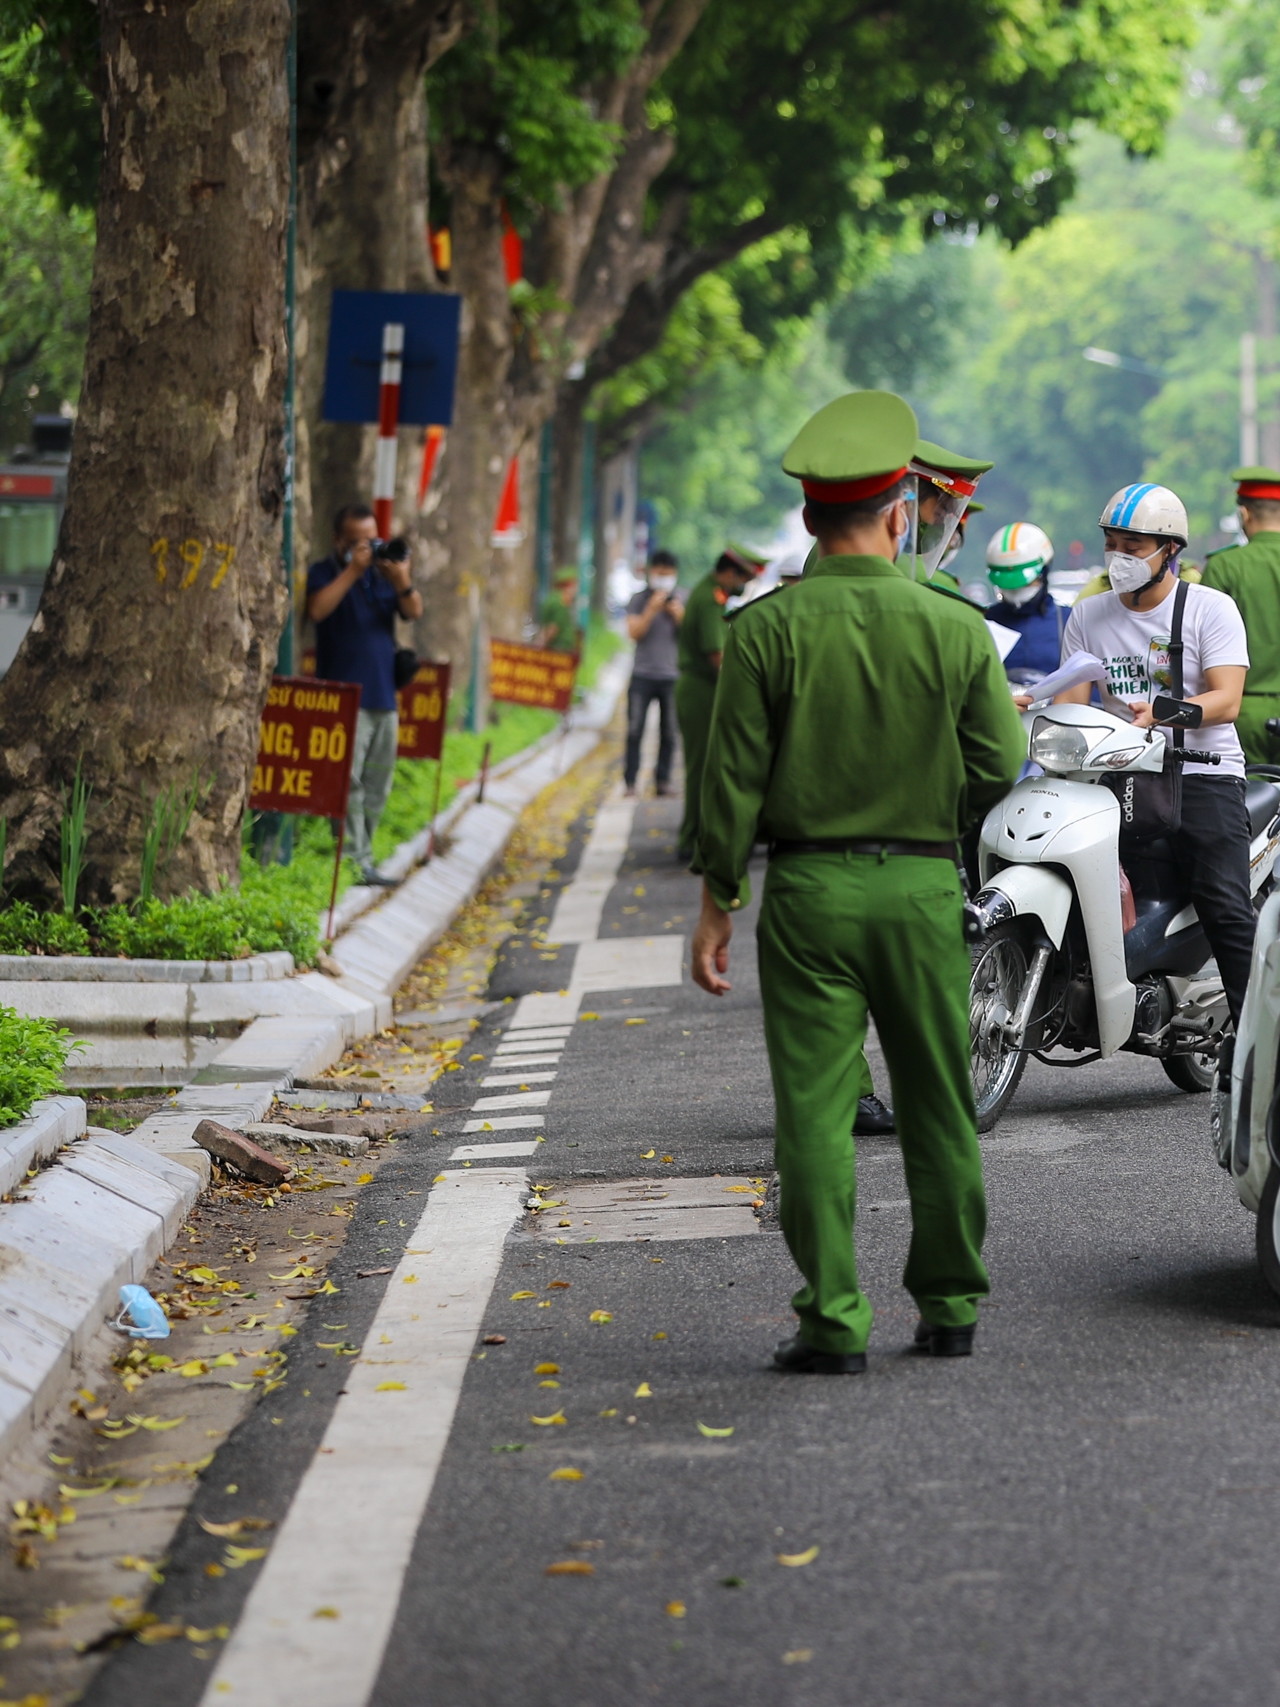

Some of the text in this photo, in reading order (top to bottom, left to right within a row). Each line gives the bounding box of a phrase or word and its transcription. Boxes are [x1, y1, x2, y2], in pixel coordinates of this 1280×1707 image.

[150, 537, 236, 591] 197
[1106, 678, 1149, 696] NHIÊN
[294, 689, 340, 712] QUÁN
[280, 768, 313, 798] XE
[1030, 789, 1060, 798] HONDA
[1122, 776, 1135, 823] adidas
